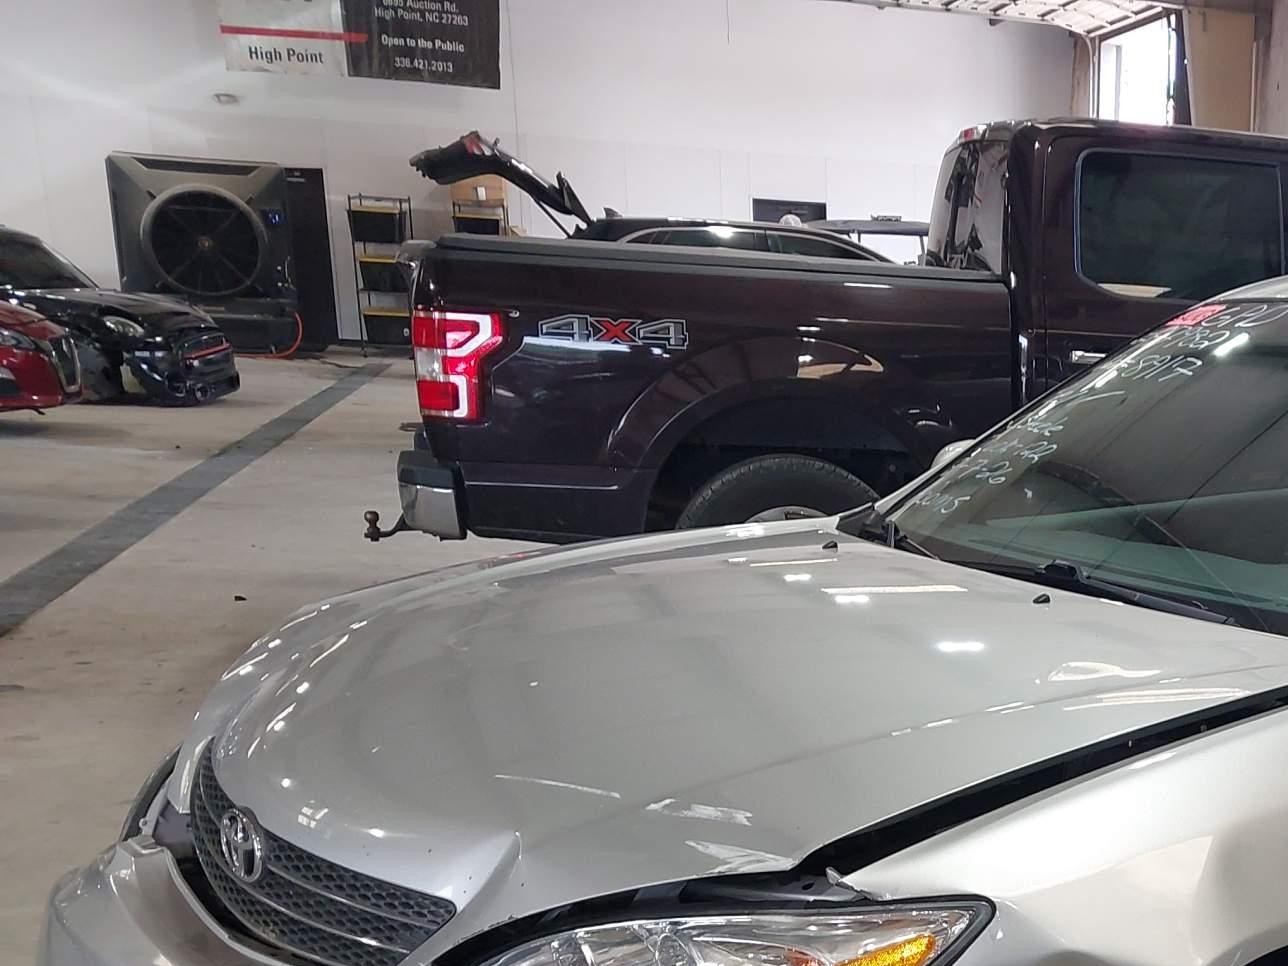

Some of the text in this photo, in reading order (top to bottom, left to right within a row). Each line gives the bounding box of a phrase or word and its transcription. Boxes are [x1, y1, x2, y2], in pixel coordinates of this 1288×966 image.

[406, 0, 442, 11] Auction
[374, 7, 395, 19] High
[425, 12, 439, 23] NC
[381, 34, 465, 53] Open to the Public
[248, 46, 324, 64] High Point
